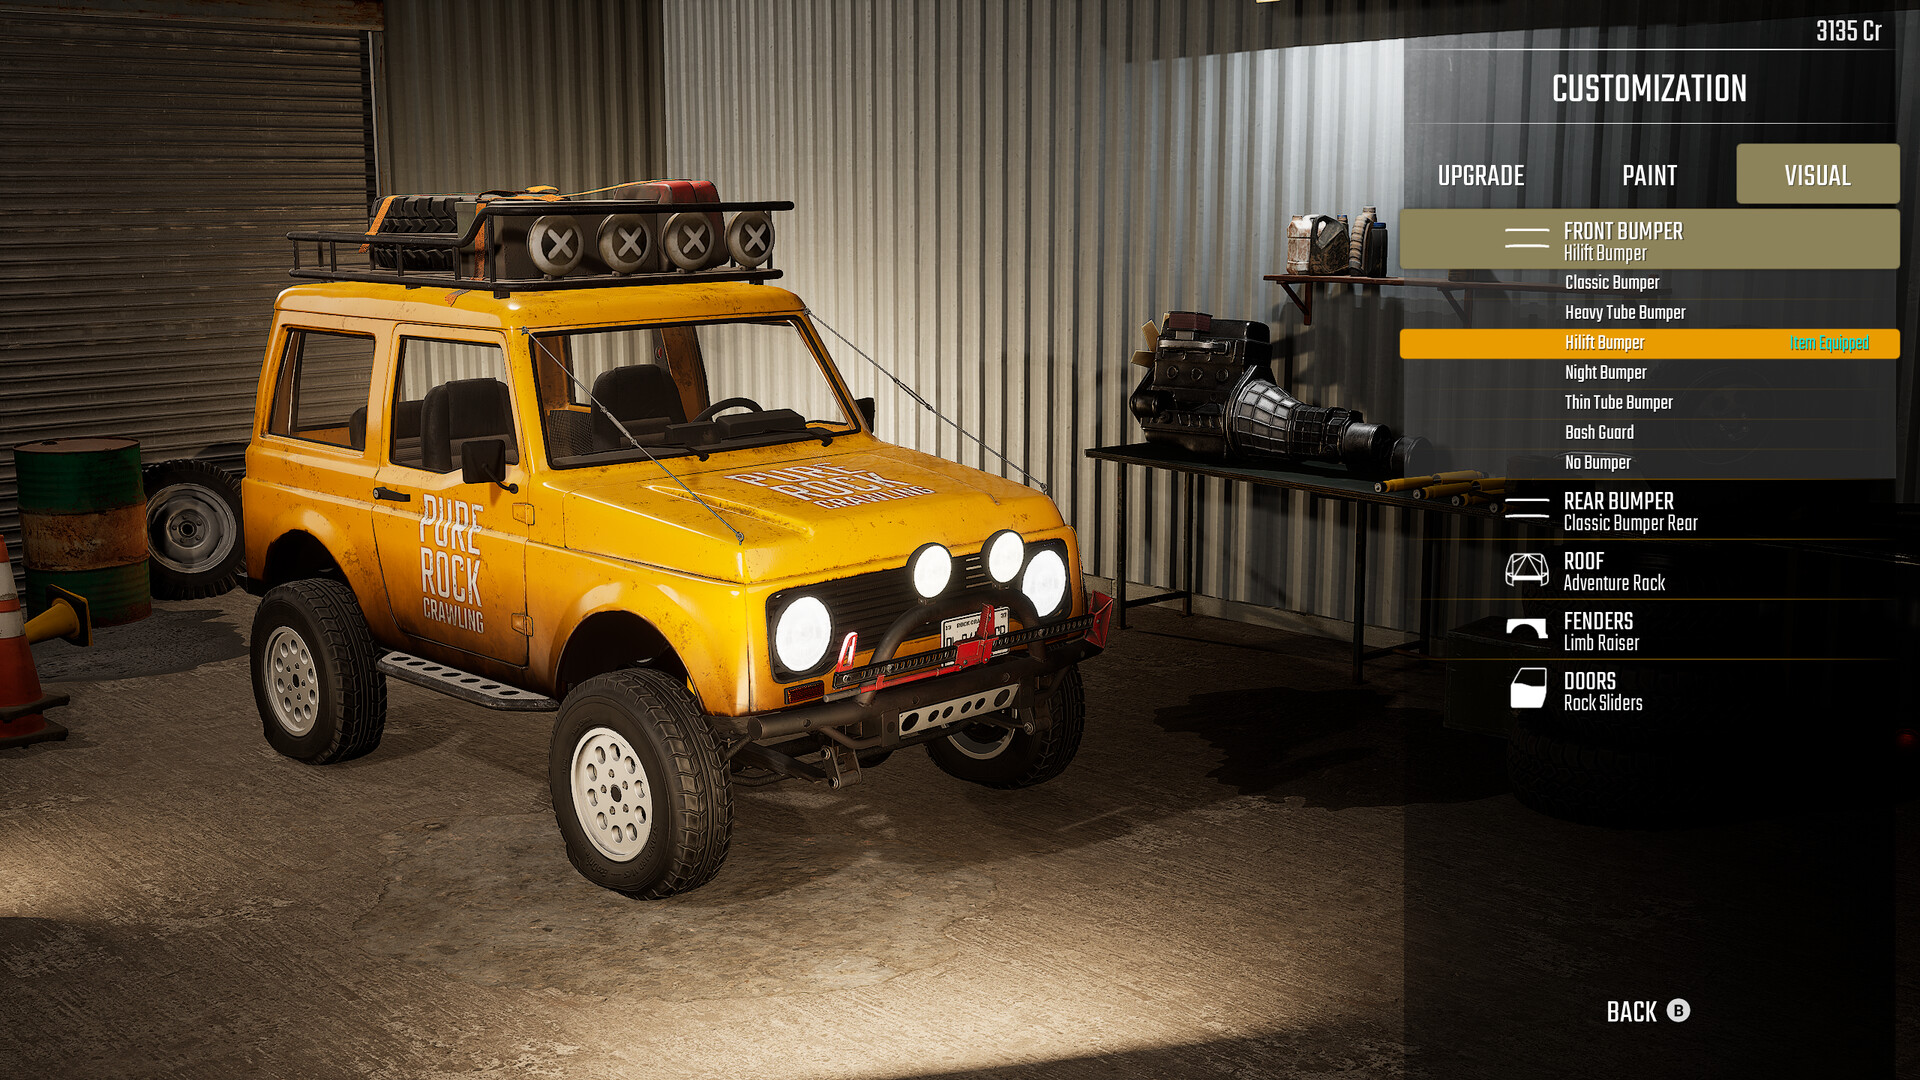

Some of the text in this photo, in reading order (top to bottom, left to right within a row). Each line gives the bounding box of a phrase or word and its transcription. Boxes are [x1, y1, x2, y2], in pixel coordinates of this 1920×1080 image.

[724, 462, 868, 487] PURE
[769, 472, 912, 501] ROCK
[813, 486, 936, 509] CRAWLING
[420, 494, 484, 555] PURE
[420, 547, 483, 607] ROCK
[423, 597, 484, 634] CRAWLING
